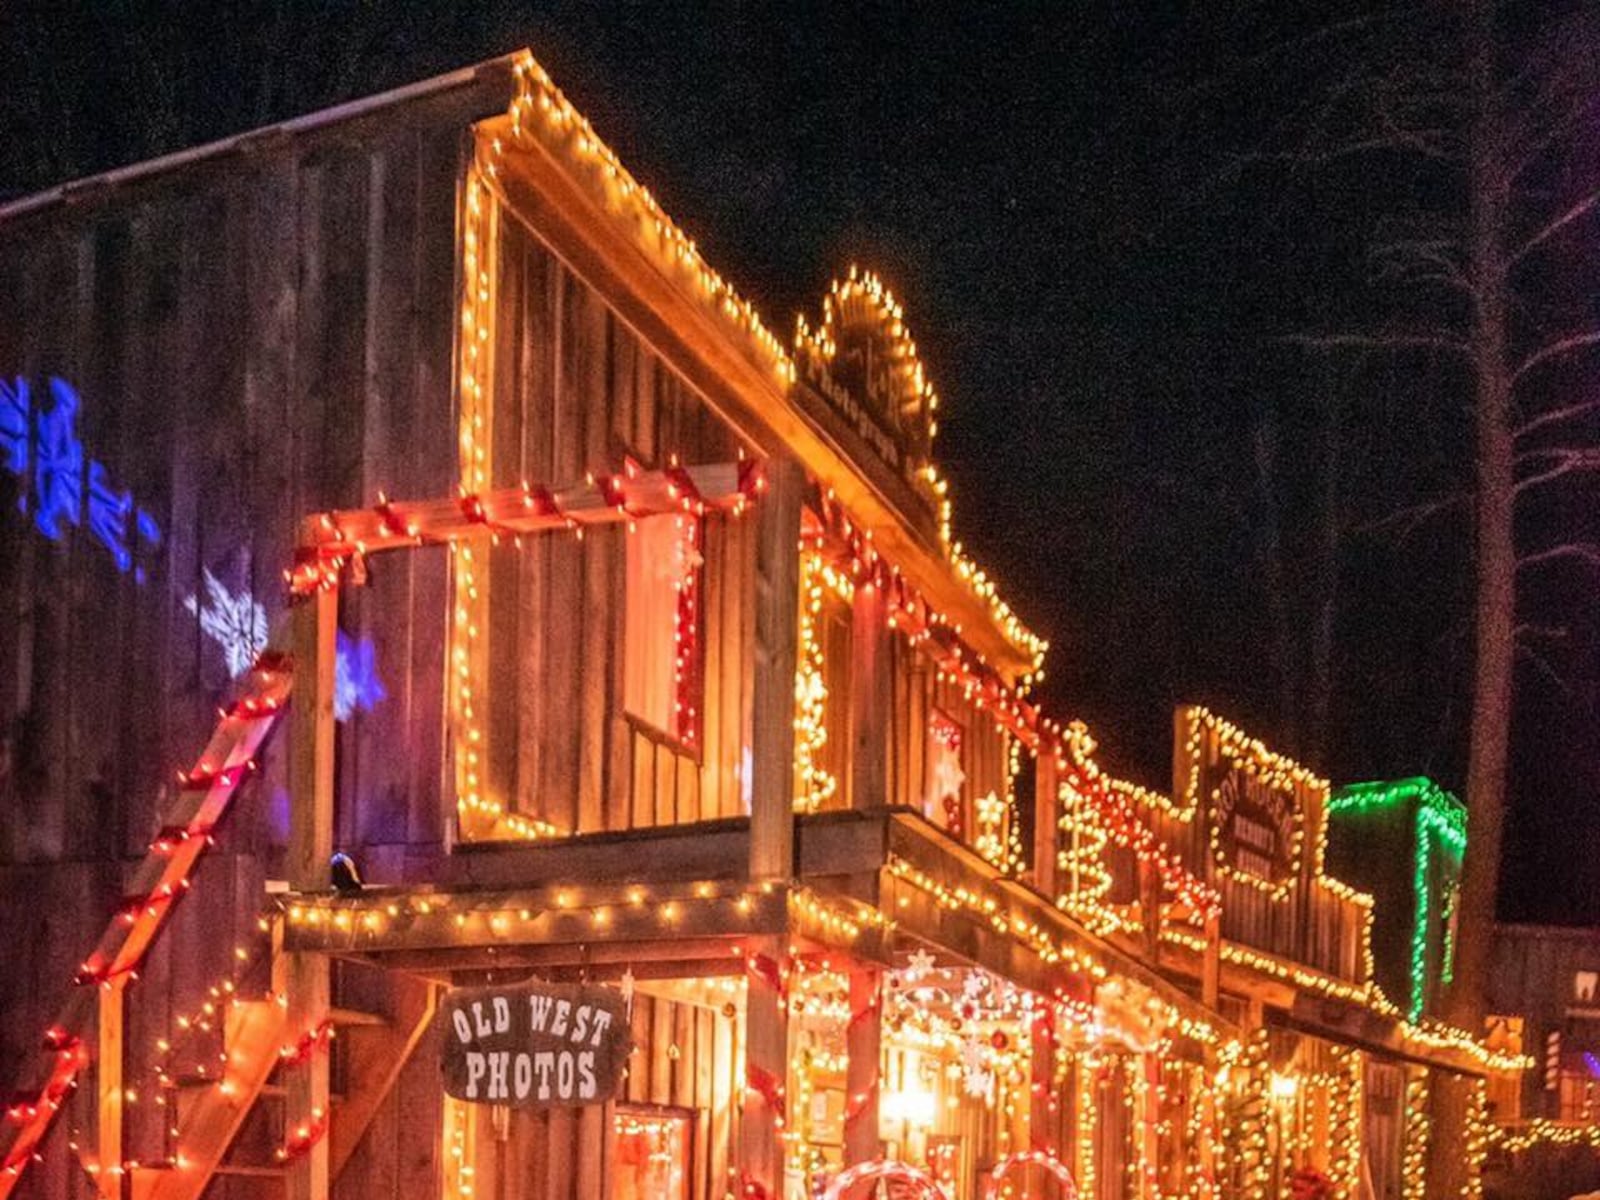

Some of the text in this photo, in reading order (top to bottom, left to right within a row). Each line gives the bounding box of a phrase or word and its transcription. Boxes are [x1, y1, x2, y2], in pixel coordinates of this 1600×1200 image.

[452, 994, 613, 1047] OLD WEST
[465, 1050, 598, 1100] PHOTOS
